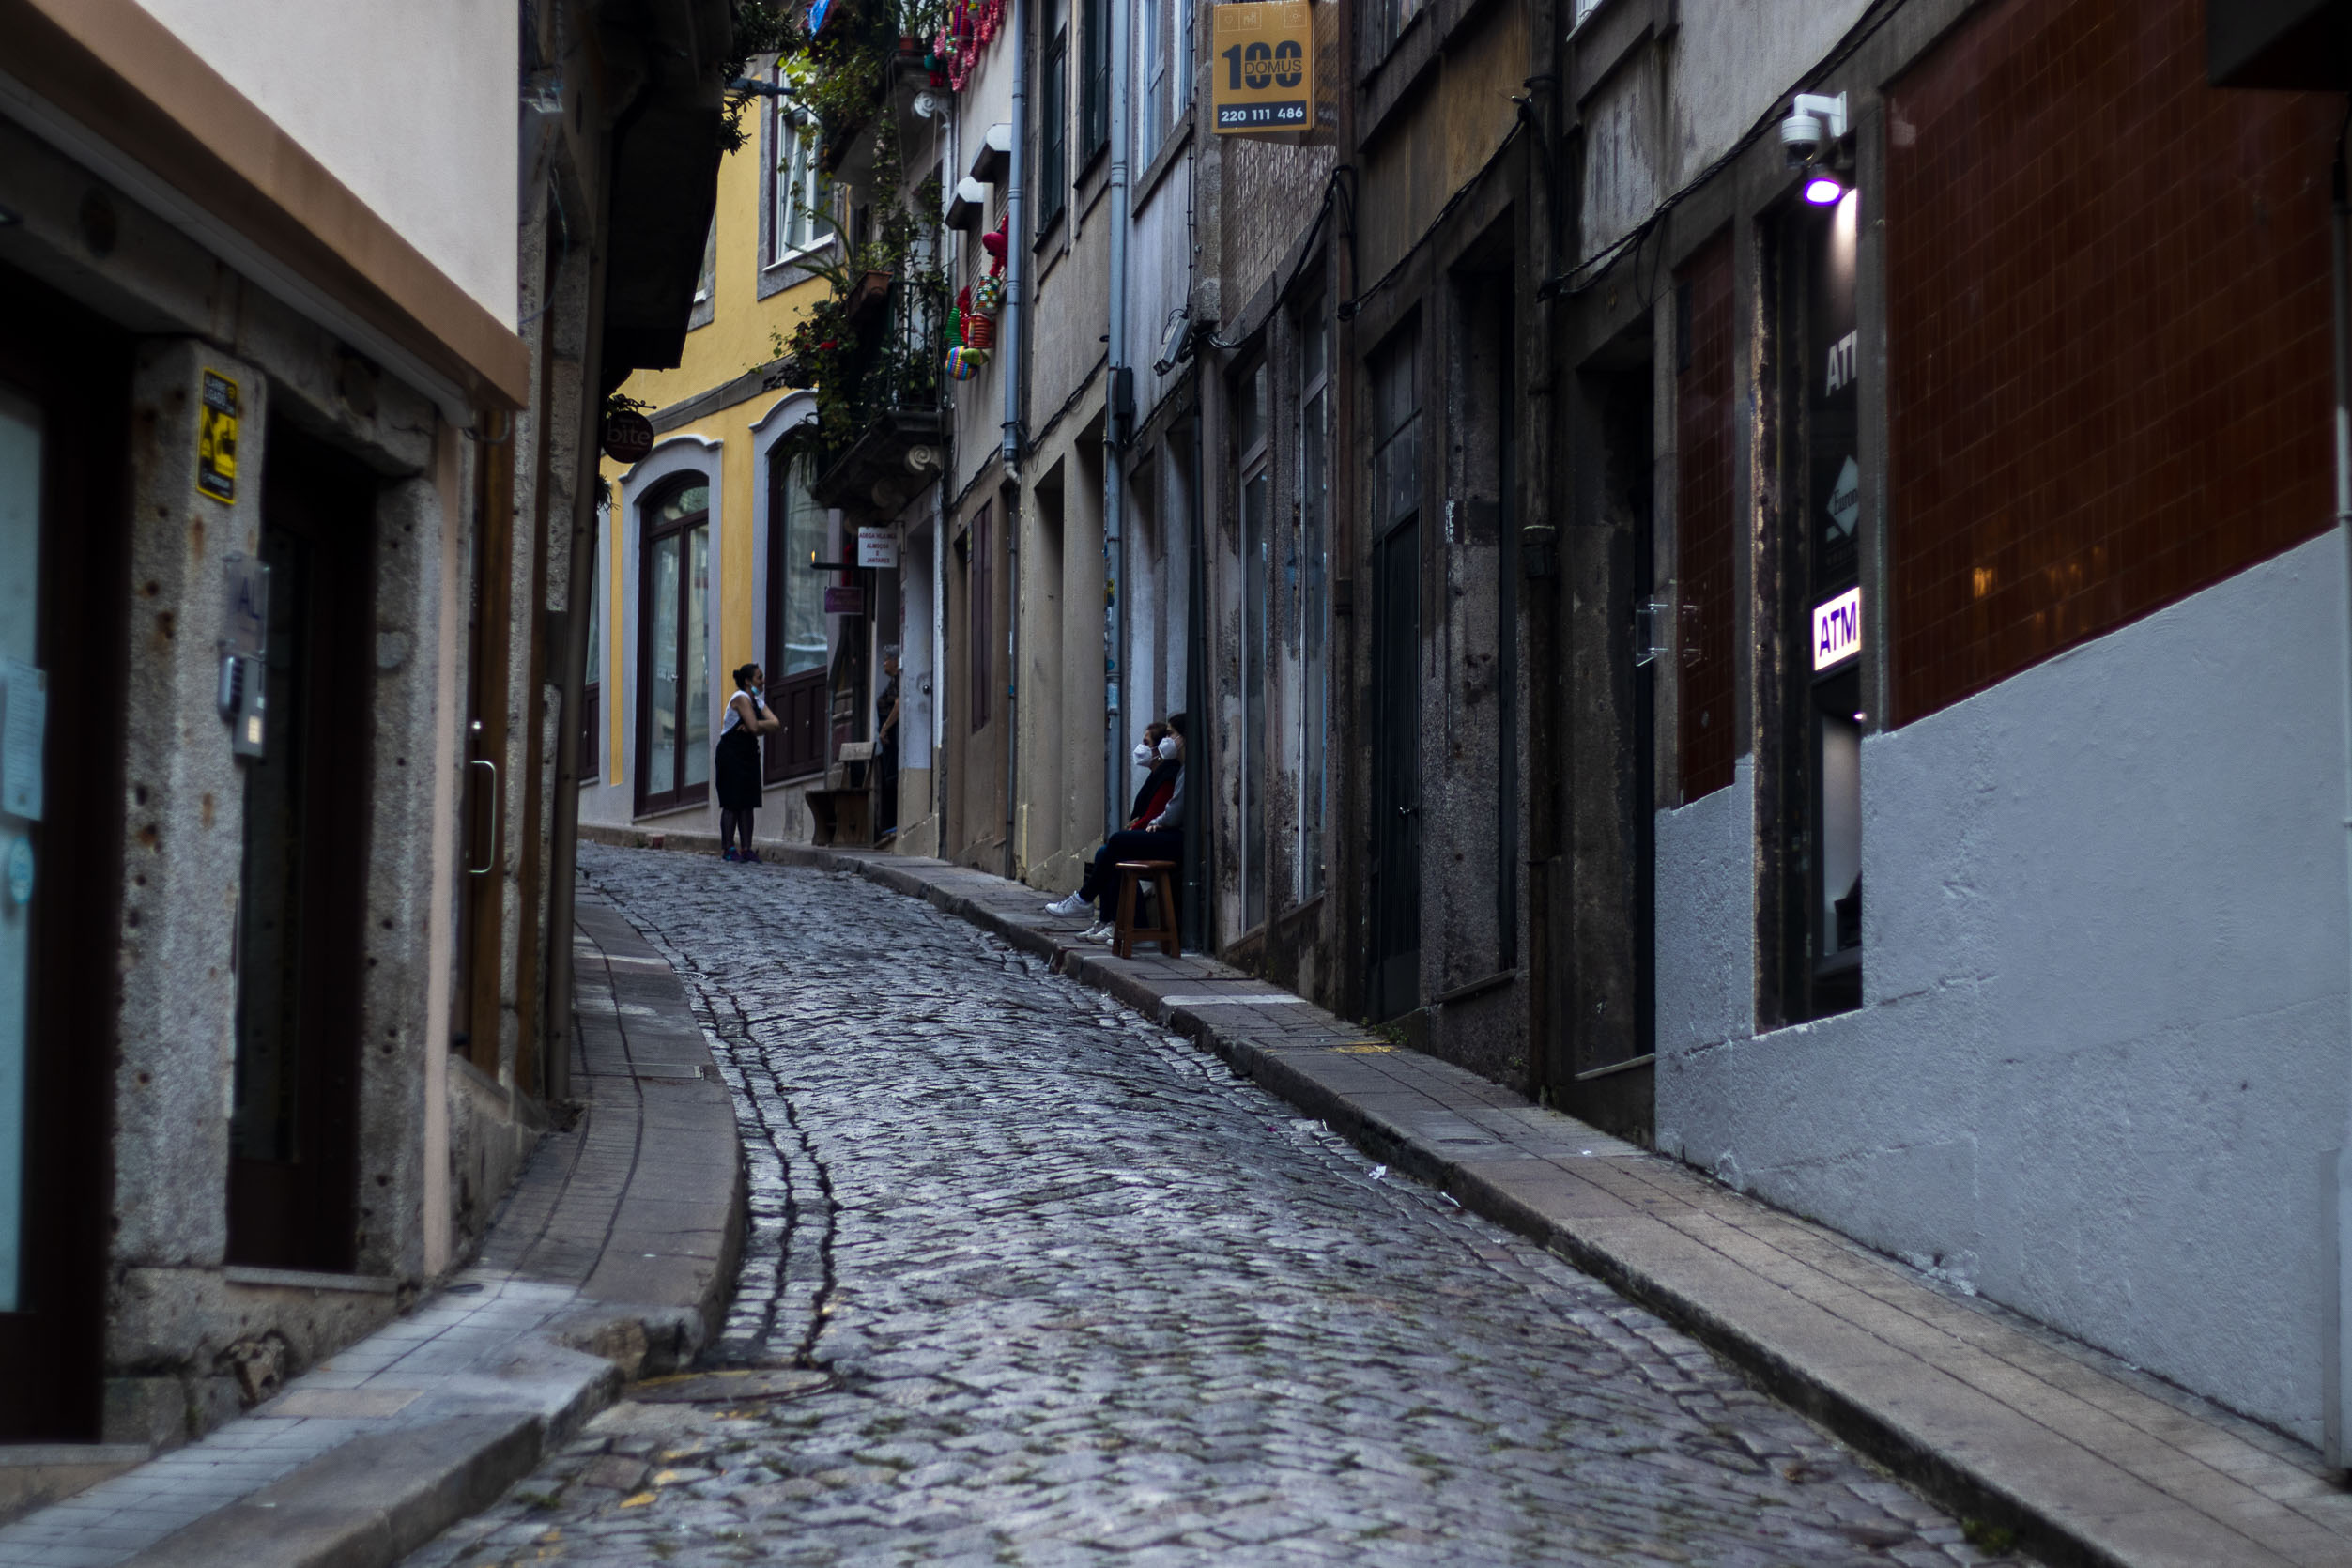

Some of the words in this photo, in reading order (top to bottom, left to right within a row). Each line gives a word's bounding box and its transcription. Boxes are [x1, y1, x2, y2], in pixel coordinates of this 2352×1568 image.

[1222, 40, 1302, 91] 100
[1244, 59, 1302, 75] DOMUS
[1221, 110, 1247, 122] 220
[1252, 108, 1270, 121] 111
[1277, 106, 1303, 120] 486
[607, 421, 651, 446] bite
[238, 576, 261, 621] AL
[1819, 601, 1857, 658] ATM
